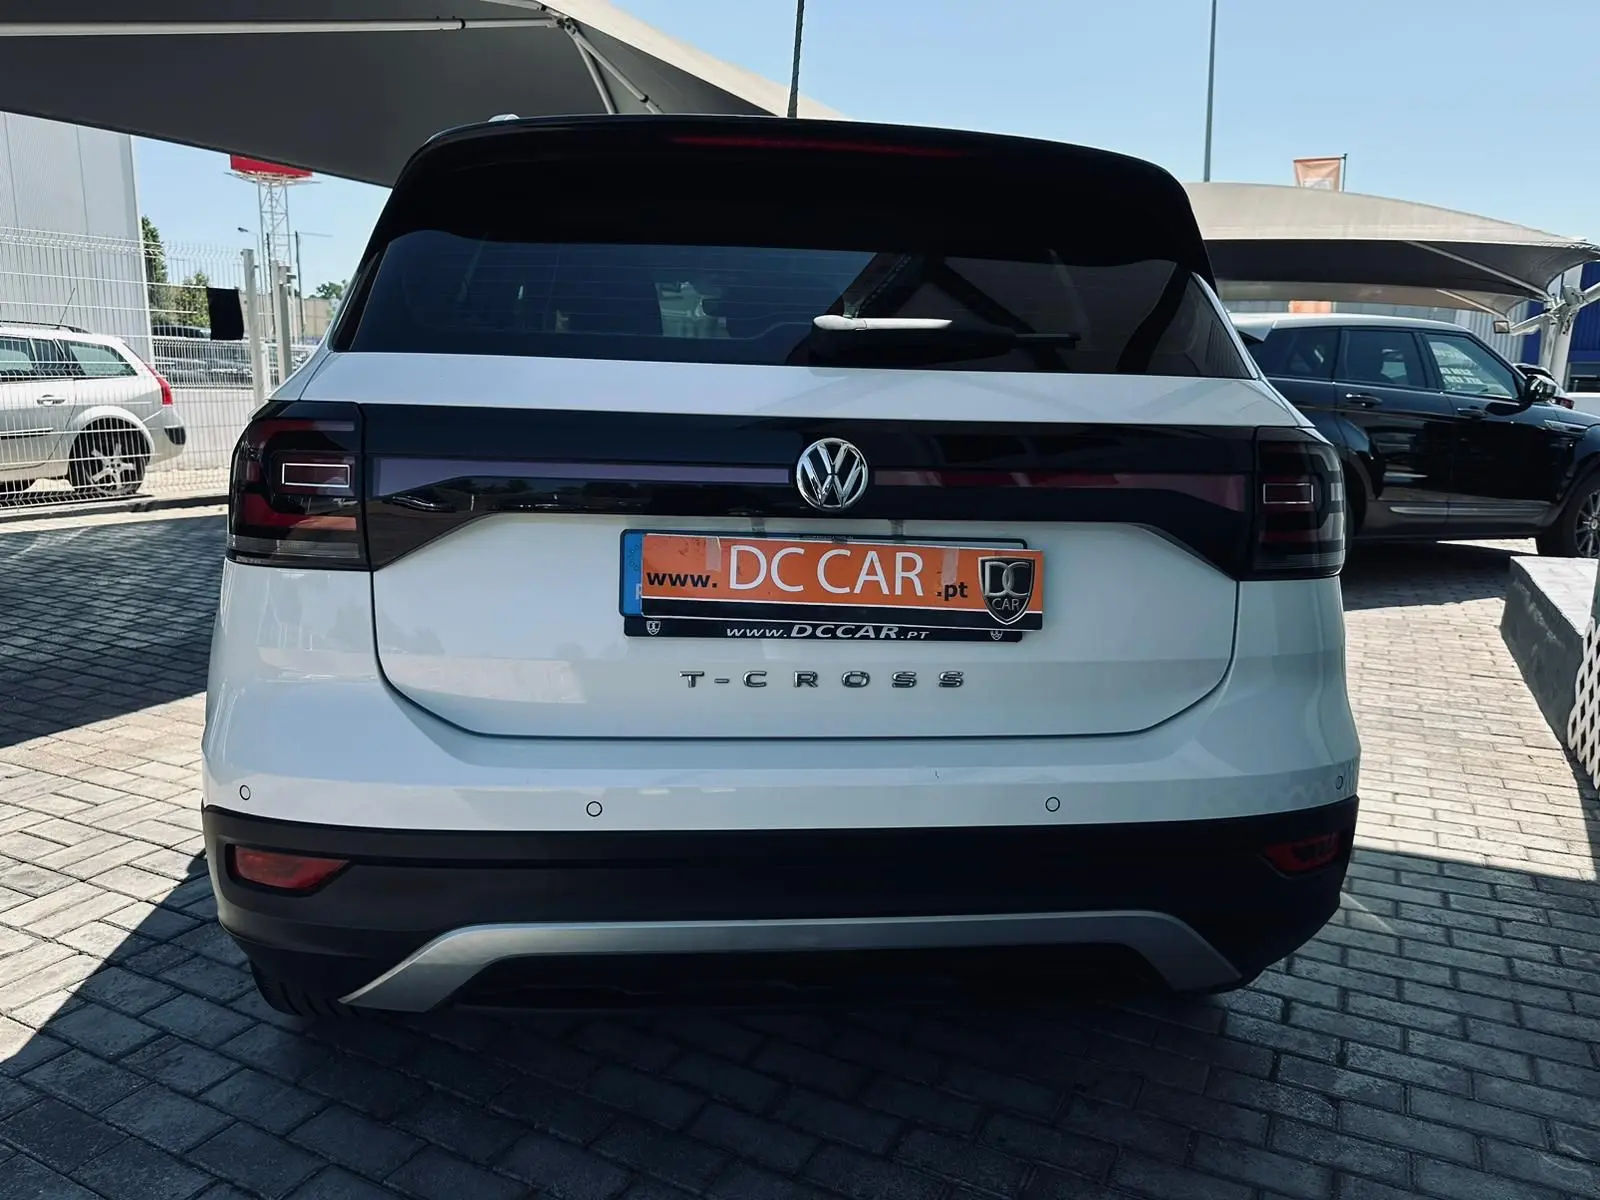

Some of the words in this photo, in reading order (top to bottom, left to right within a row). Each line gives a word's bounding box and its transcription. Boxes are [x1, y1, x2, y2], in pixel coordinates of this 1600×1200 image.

[647, 571, 718, 588] www.
[729, 544, 805, 592] DC
[816, 548, 924, 597] CAR
[936, 582, 968, 601] .pt
[992, 598, 1020, 611] CAR
[726, 624, 930, 640] www.DCCAR.PT
[680, 671, 964, 688] T-CROSS
